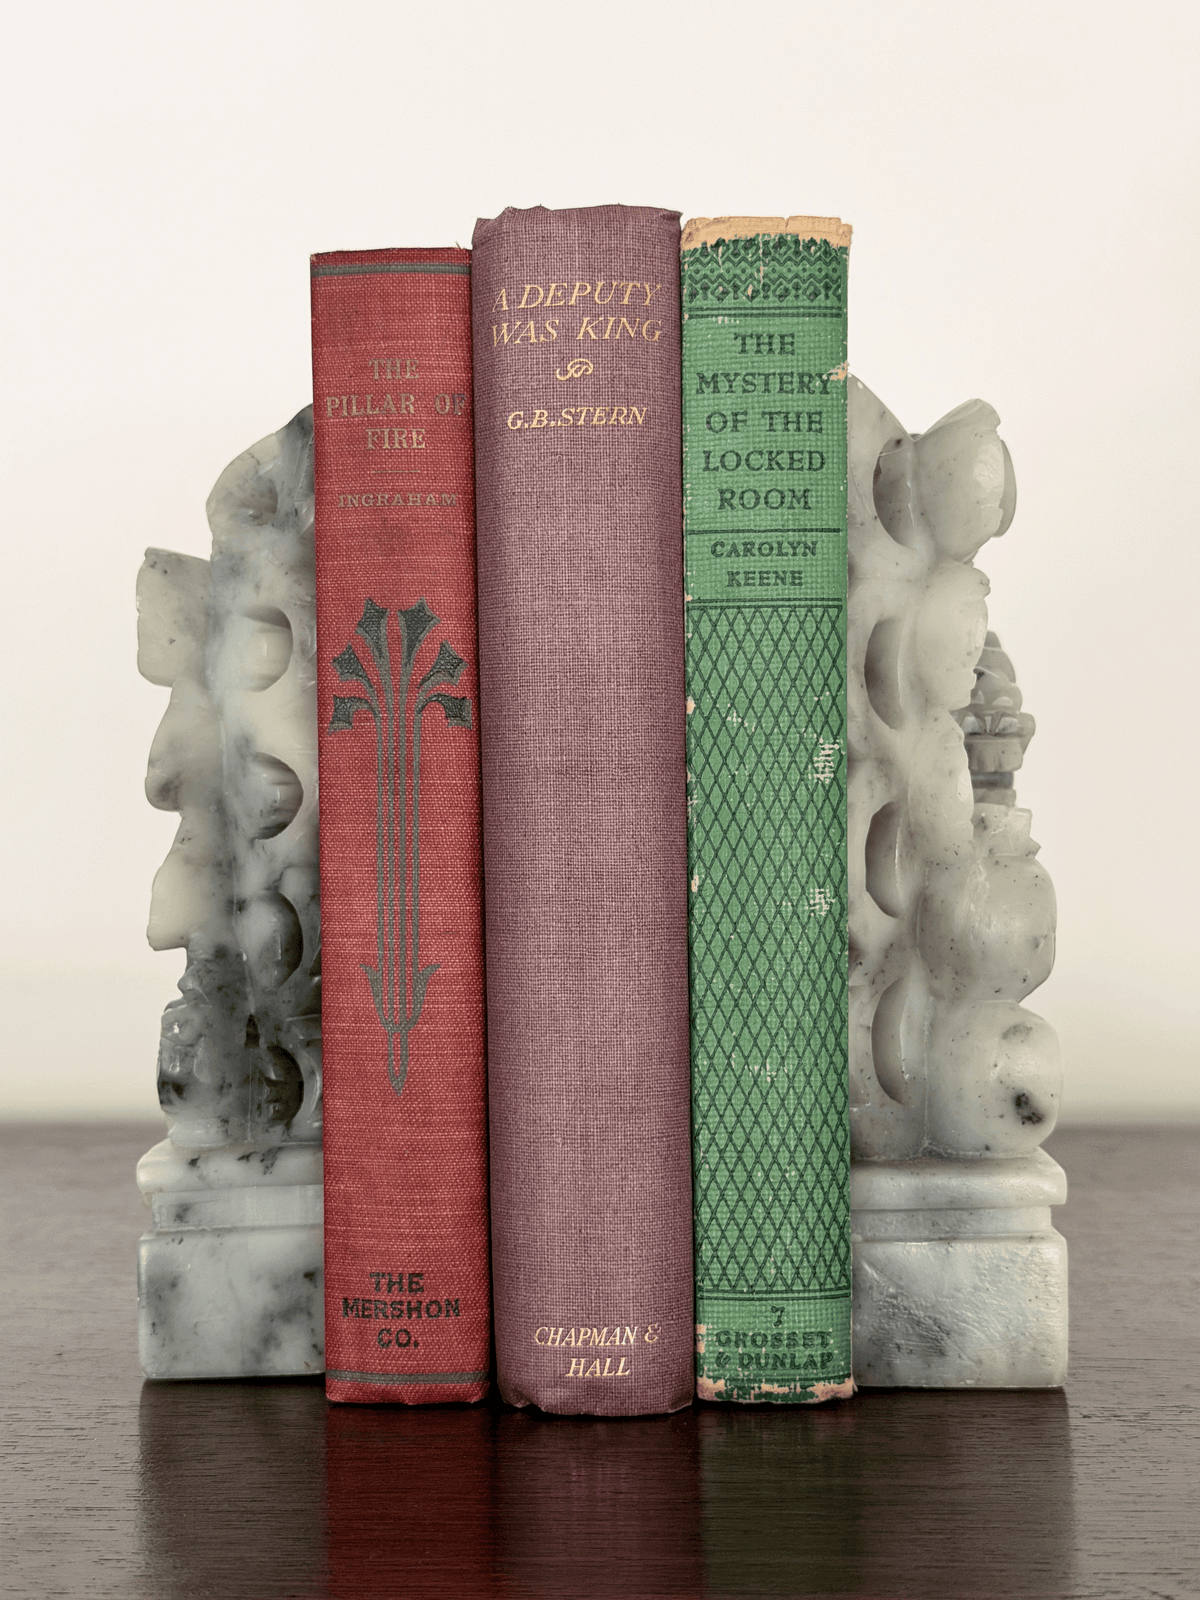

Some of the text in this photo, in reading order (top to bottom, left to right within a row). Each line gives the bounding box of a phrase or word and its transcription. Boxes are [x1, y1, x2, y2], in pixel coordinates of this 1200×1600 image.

[492, 281, 661, 312] A DEPUTY
[492, 317, 662, 346] WAS KING
[734, 333, 795, 355] THE
[368, 358, 419, 380] THE
[695, 371, 831, 395] MYSTERY
[326, 393, 466, 418] PILLAR OF
[705, 410, 823, 433] OF THE
[366, 428, 425, 449] FIRE
[702, 450, 826, 472] LOCKED
[338, 493, 457, 507] INGRAHAM
[717, 488, 812, 510] ROOM
[710, 540, 818, 557] CAROLYN
[726, 570, 803, 587] KEENE
[369, 1272, 424, 1293] THE
[342, 1298, 460, 1319] MERSHON
[771, 1306, 785, 1327] 7
[377, 1328, 419, 1348] CO.
[535, 1322, 661, 1346] CHAPMAN &
[716, 1331, 831, 1349] GROSSET
[565, 1356, 630, 1377] HALL
[715, 1351, 833, 1370] & DUNLAP
